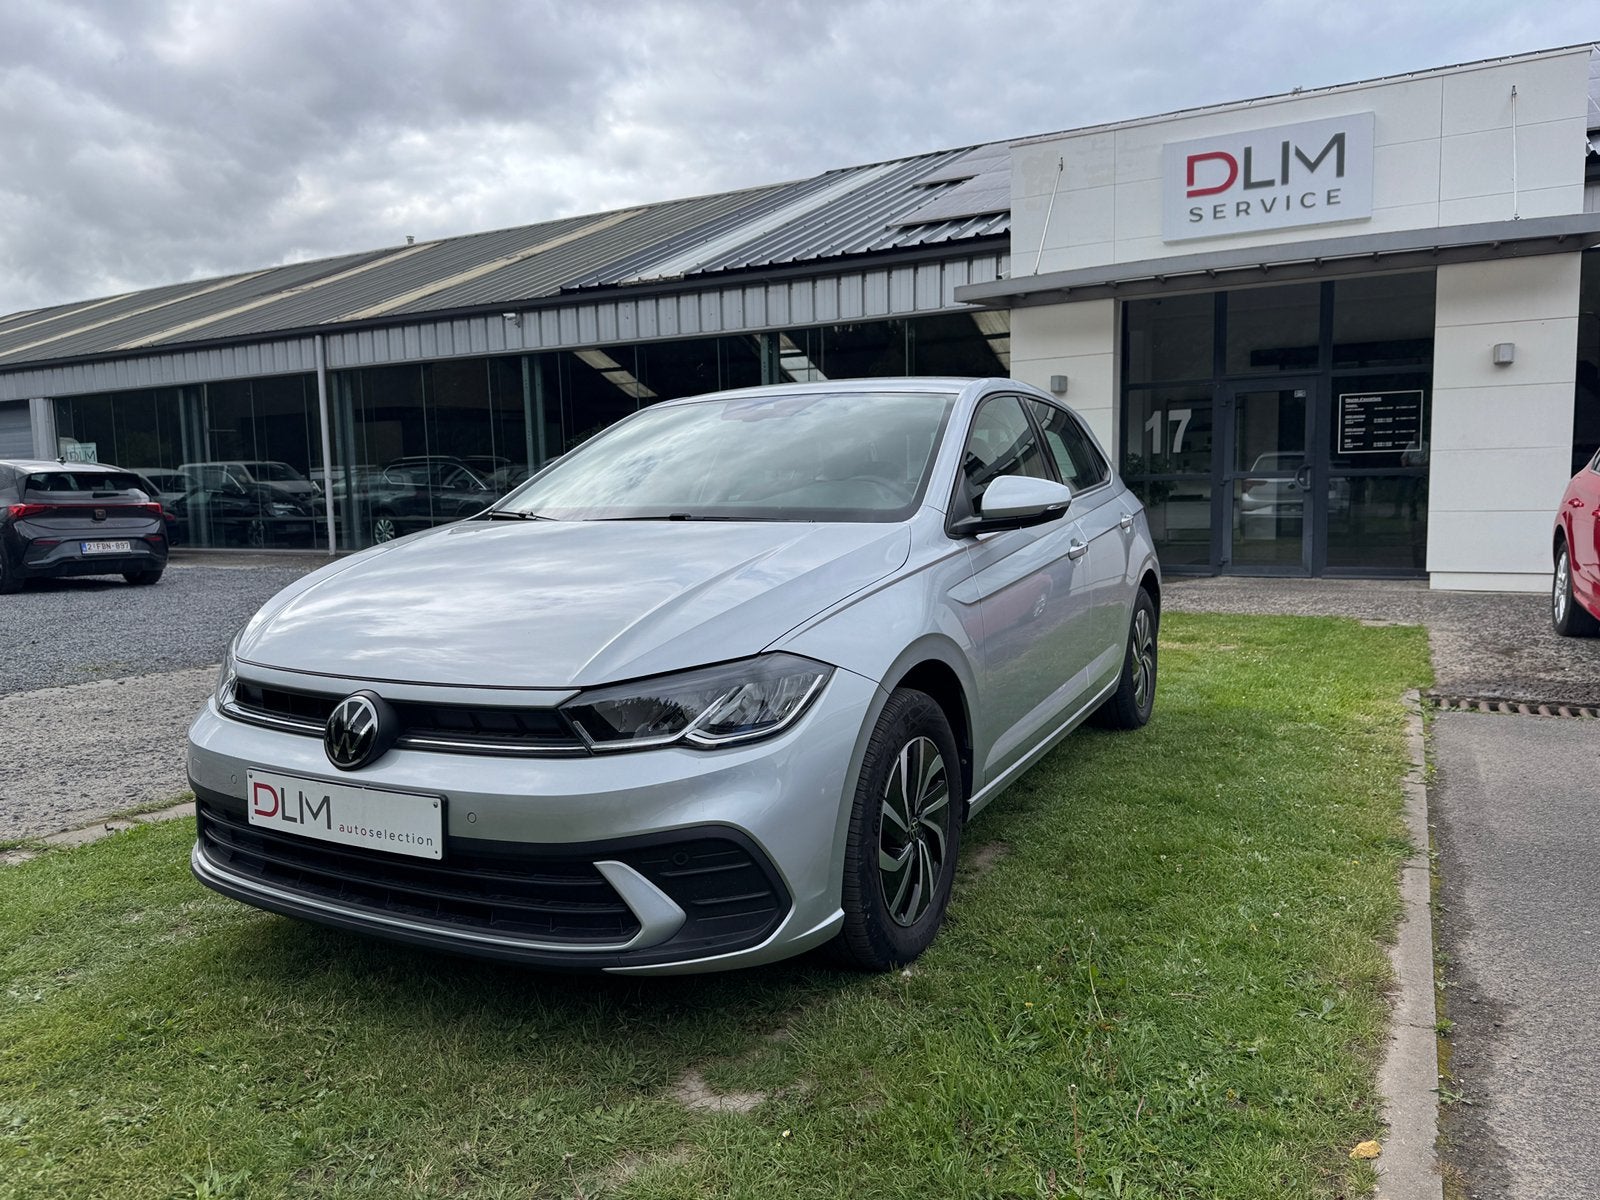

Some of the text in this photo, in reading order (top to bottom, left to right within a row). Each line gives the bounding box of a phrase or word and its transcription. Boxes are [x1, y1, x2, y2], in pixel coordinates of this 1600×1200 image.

[1187, 132, 1346, 199] DLM
[1189, 188, 1341, 223] SERVICE
[1145, 408, 1192, 454] 17
[253, 782, 433, 846] DLM autoselection
